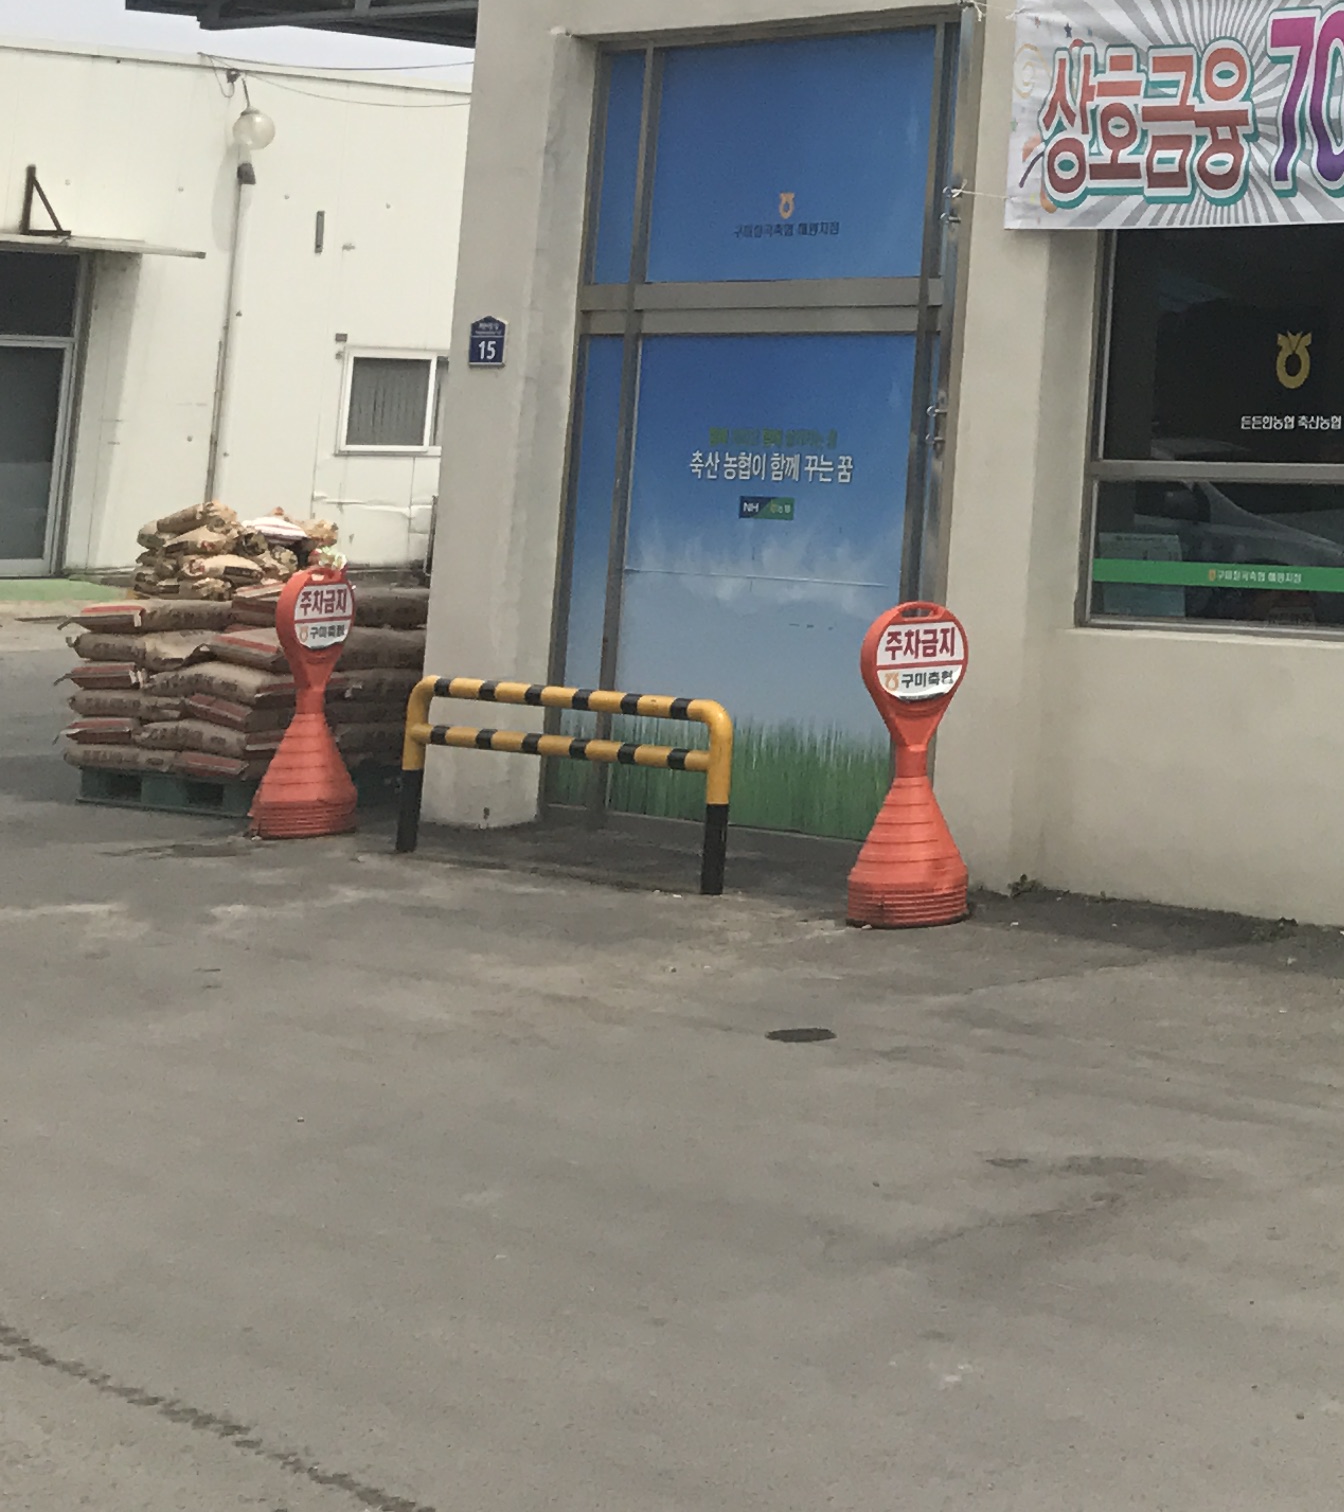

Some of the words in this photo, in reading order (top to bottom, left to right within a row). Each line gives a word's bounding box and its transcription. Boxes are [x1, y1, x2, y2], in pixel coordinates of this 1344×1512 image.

[1041, 41, 1256, 195] 상호금융
[478, 340, 497, 360] 15
[1240, 415, 1296, 430] 든든한농협
[1297, 415, 1342, 430] 축산농협
[689, 449, 721, 479] 축산
[723, 451, 767, 481] 농협이
[769, 452, 802, 483] 함께
[803, 454, 835, 483] 꾸는
[836, 455, 854, 484] 꿈
[742, 502, 760, 513] NH
[299, 588, 348, 617] 주차금지
[884, 626, 956, 661] 주차금지
